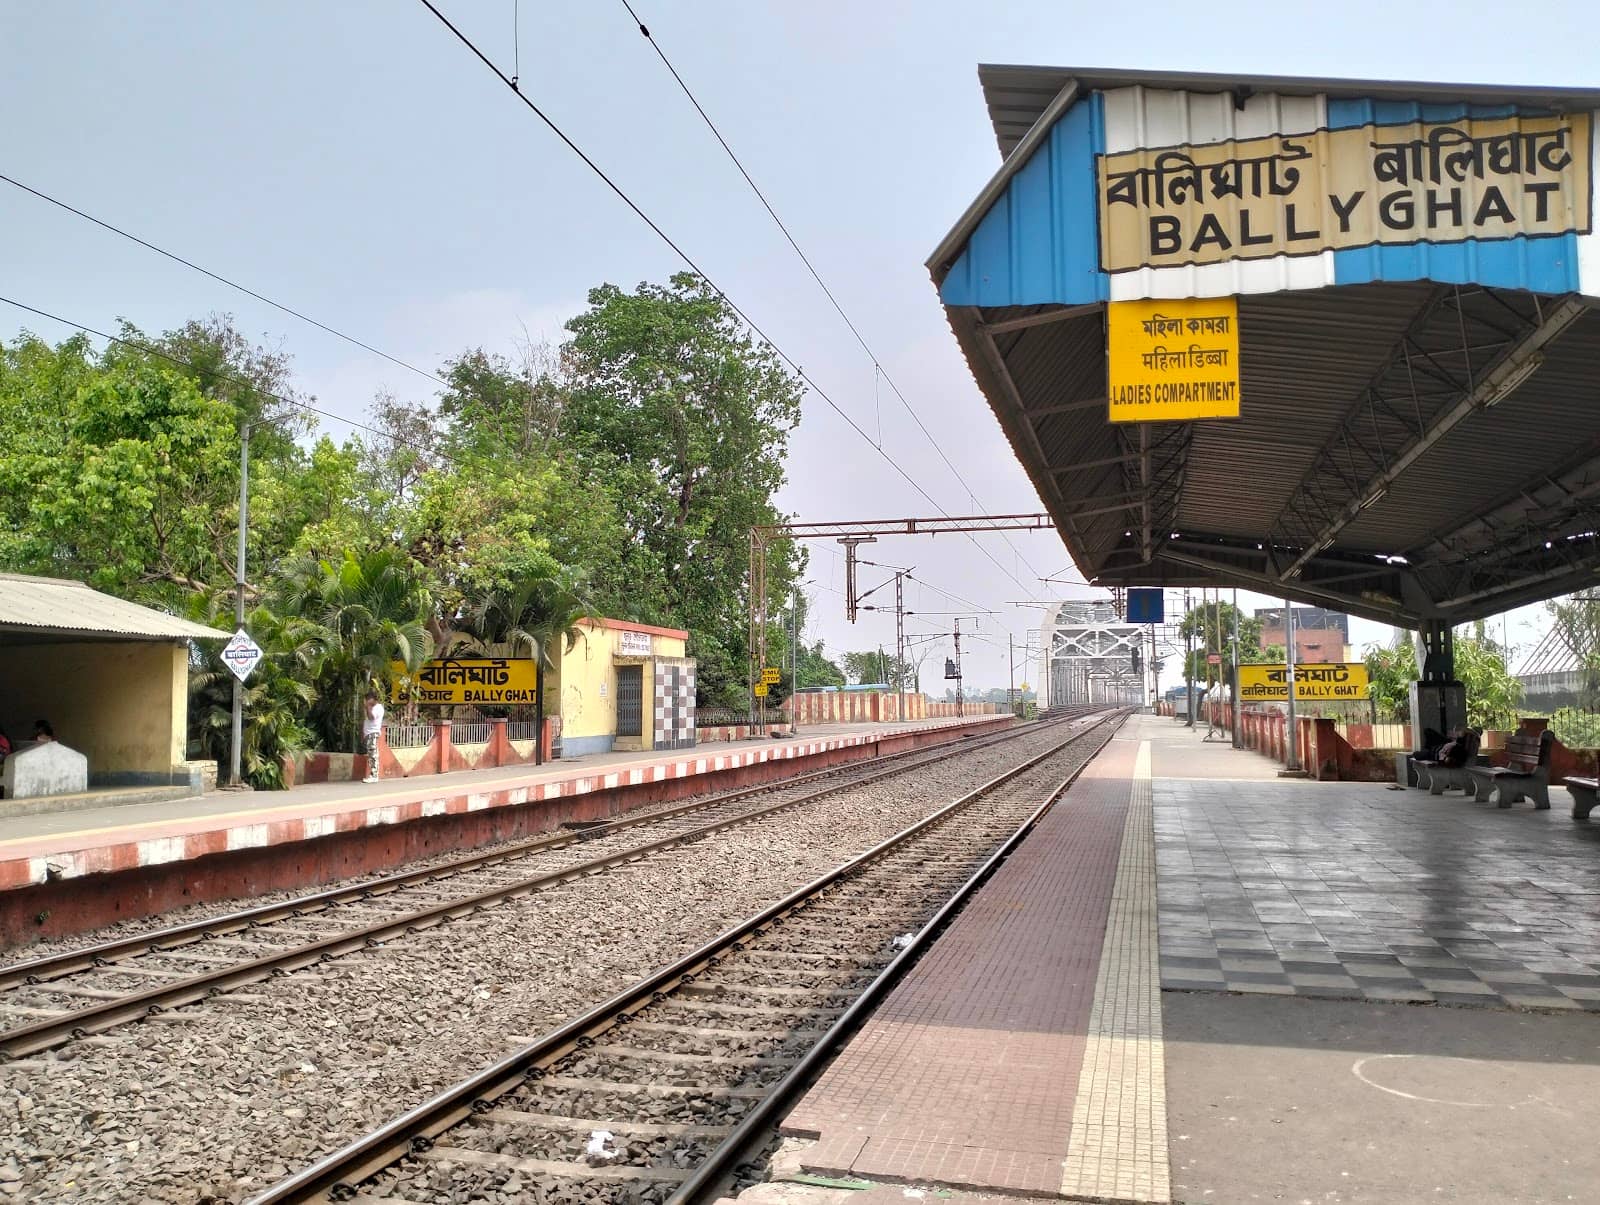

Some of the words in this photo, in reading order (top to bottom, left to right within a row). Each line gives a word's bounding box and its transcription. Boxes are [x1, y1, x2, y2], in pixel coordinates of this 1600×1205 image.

[1370, 126, 1572, 186] बालिघाट
[1106, 140, 1313, 208] বালিঘাট
[1141, 313, 1183, 338] মহিলা
[1185, 316, 1230, 335] কামরা
[1141, 346, 1186, 371] महिला
[1113, 384, 1151, 405] LADIES
[1154, 381, 1236, 403] COMPARTMENT
[419, 660, 510, 686] বালিঘাট
